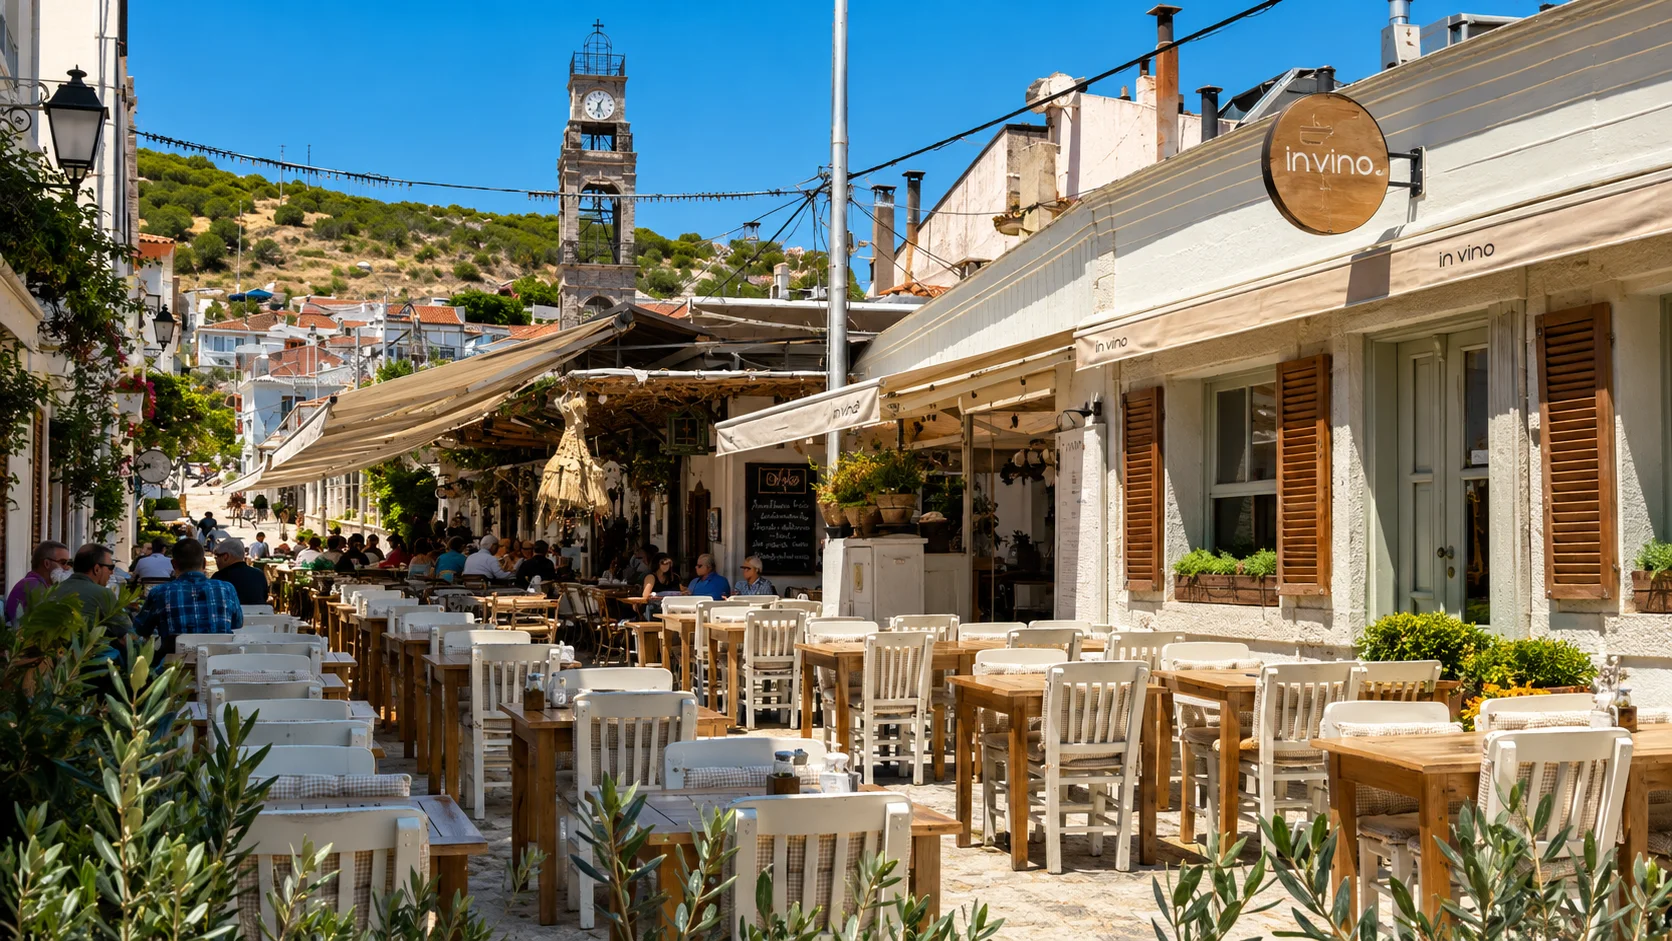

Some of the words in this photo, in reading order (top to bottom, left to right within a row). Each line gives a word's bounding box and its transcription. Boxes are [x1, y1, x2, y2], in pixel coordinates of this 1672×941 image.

[1439, 251, 1453, 268] in
[1457, 243, 1495, 262] vino
[1095, 340, 1104, 353] in
[1106, 336, 1128, 350] vino
